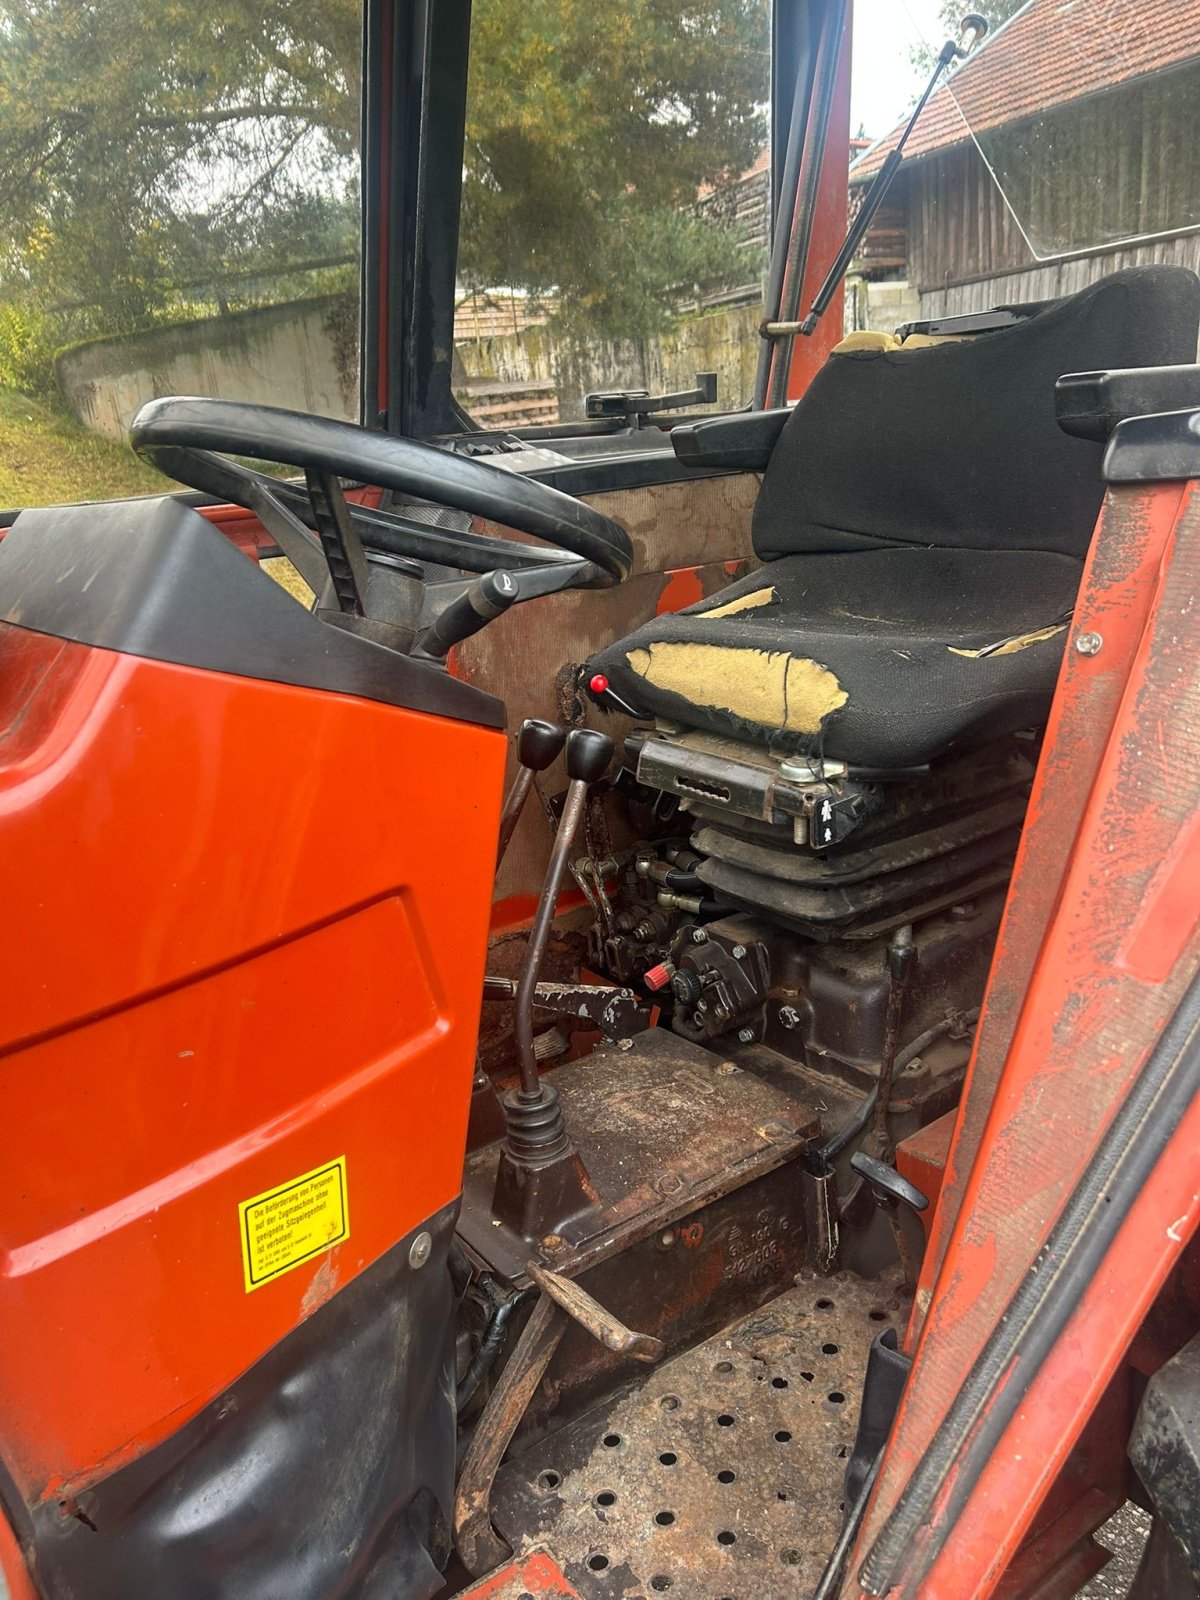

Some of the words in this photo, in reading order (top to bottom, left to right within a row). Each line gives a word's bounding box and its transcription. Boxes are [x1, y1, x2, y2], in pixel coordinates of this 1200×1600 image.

[254, 1210, 264, 1219] Die
[300, 1187, 309, 1197] von
[310, 1175, 334, 1191] Personen
[255, 1220, 264, 1231] auf
[267, 1215, 276, 1225] der
[278, 1197, 314, 1220] Zugmaschine
[316, 1190, 328, 1201] ohne
[256, 1224, 284, 1244] geeignete
[286, 1201, 327, 1228] Sitzgelegenheit
[266, 1230, 293, 1250] verboten!
